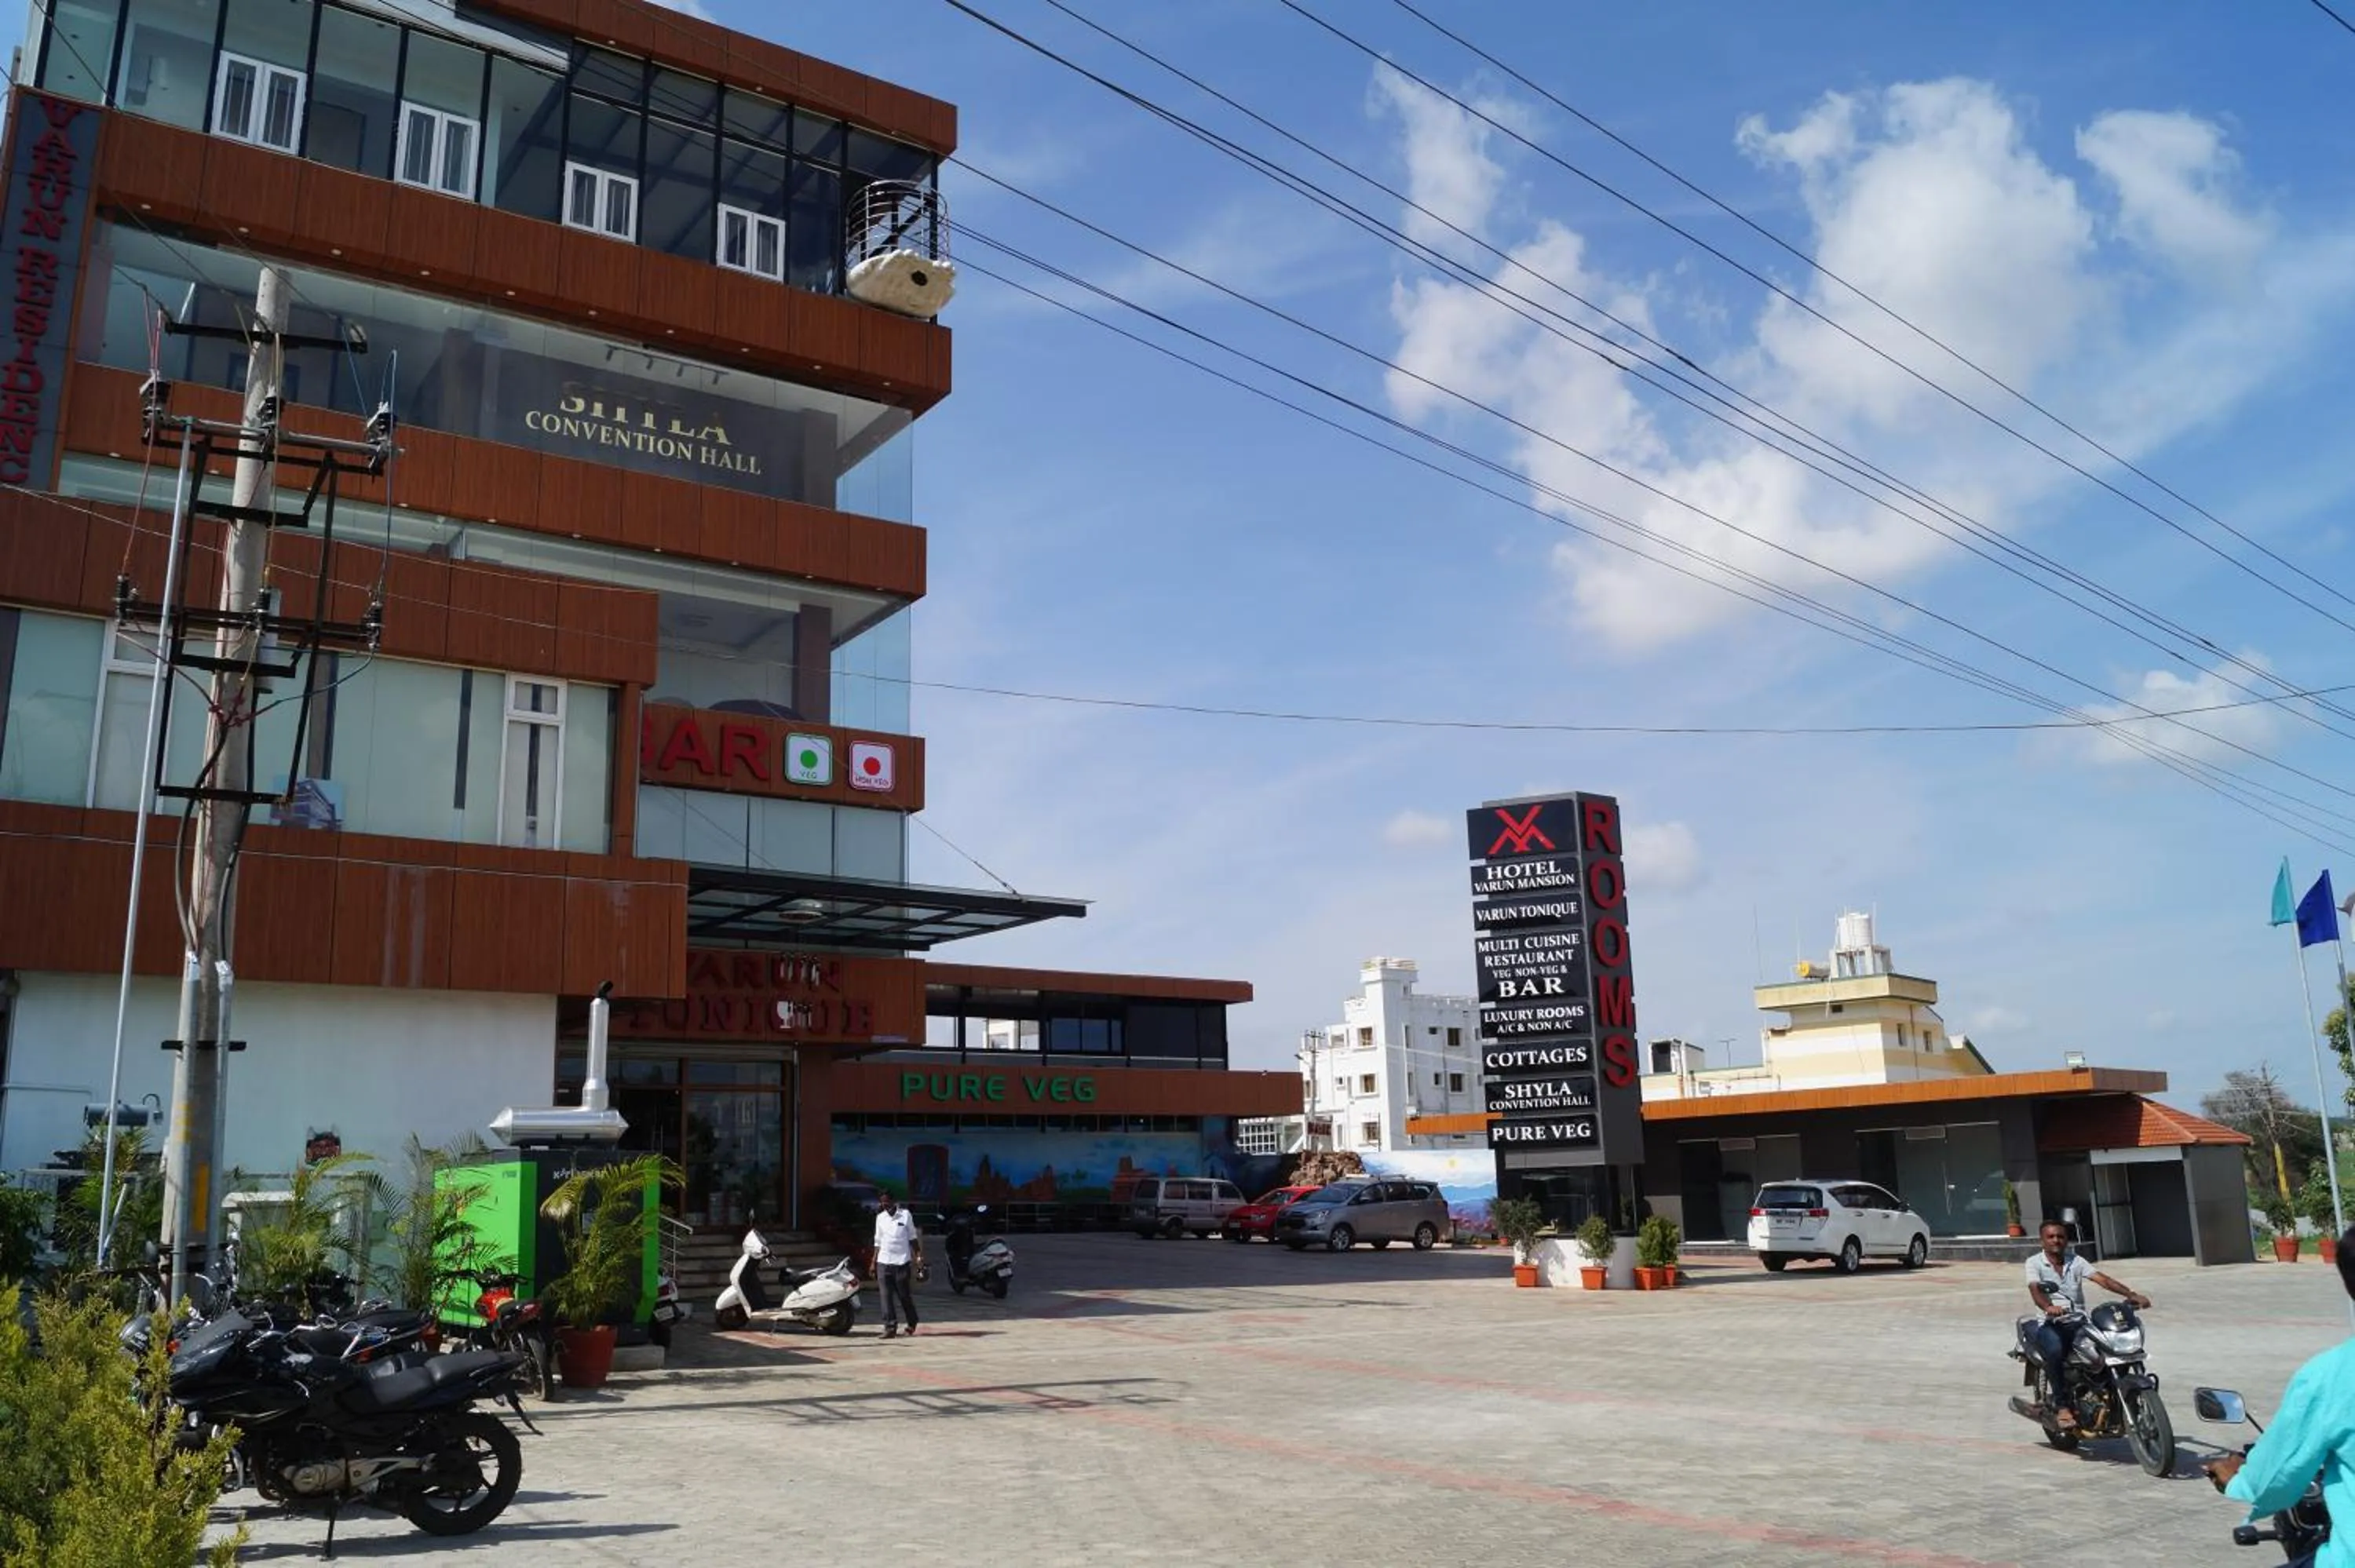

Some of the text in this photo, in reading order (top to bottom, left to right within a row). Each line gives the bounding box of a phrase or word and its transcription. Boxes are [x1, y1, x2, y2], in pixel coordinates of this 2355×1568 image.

[525, 410, 761, 476] CONVENTION HALL
[1486, 860, 1561, 880] HOTEL
[1474, 873, 1575, 892] VARUN MANSION
[1476, 901, 1578, 921] VARUN TONIQUE
[1478, 933, 1580, 953] MULTI CUISINE
[1583, 800, 1638, 1088] ROOMS
[1484, 949, 1574, 968] RESTAURANT
[1492, 968, 1511, 979] VEG
[1561, 965, 1568, 974] &
[1498, 977, 1565, 997] BAR
[1484, 1005, 1584, 1023] LUXURY ROOMS
[1497, 1019, 1572, 1034] A/C & NON A/C
[1486, 1046, 1587, 1068] COTTAGES
[900, 1071, 1096, 1103] PURE VEG
[1505, 1081, 1572, 1099] SHYLA
[1489, 1096, 1590, 1110] CONVENTION HALL
[1492, 1123, 1591, 1142] PURE VEG
